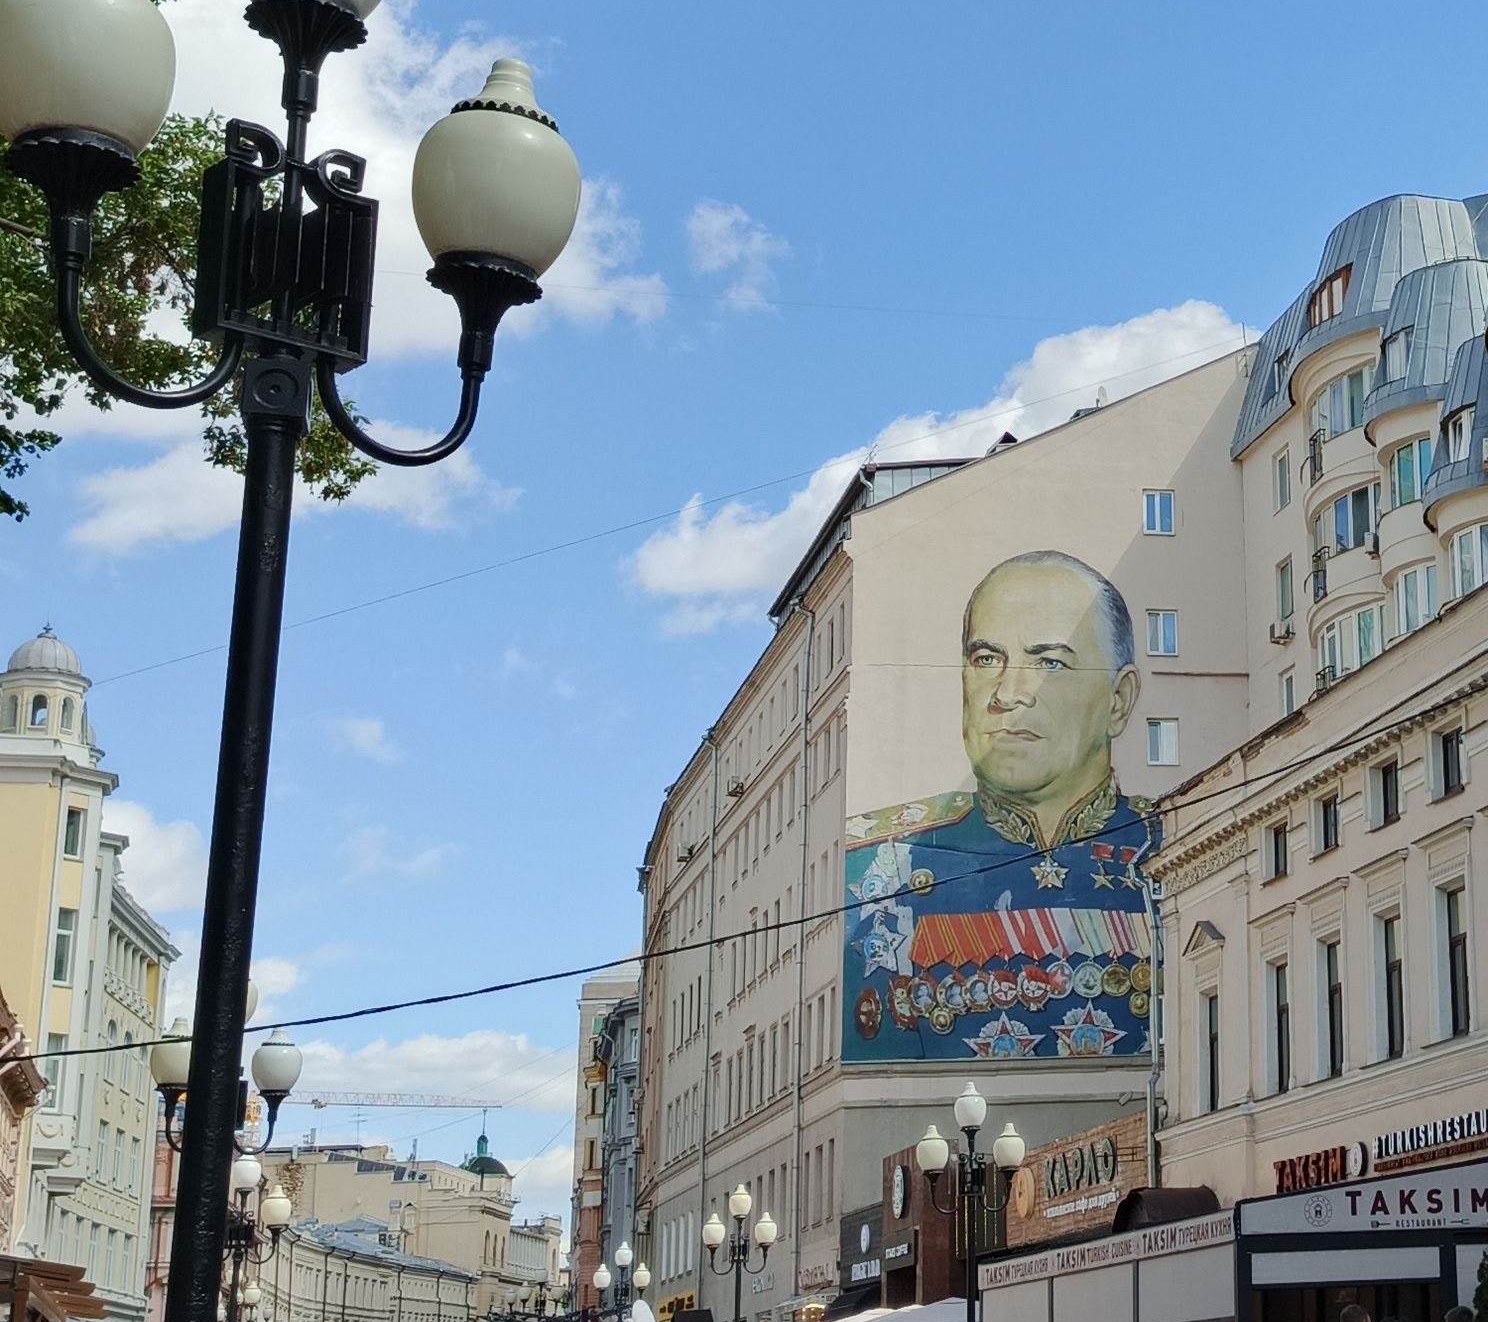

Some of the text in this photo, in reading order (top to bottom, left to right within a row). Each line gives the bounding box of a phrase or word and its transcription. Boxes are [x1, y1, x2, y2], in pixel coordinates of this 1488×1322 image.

[1044, 1138, 1116, 1201] КАРЛО
[1273, 1146, 1347, 1194] TAKSIM
[1142, 1216, 1232, 1254] TAKSIM ТУРЕЦКАЯ КУХНЯ
[1396, 1218, 1447, 1228] RESTAURANT
[1056, 1247, 1086, 1271] TAKSIM
[1111, 1238, 1132, 1259] CUISINE
[985, 1264, 1011, 1286] TAKSIM
